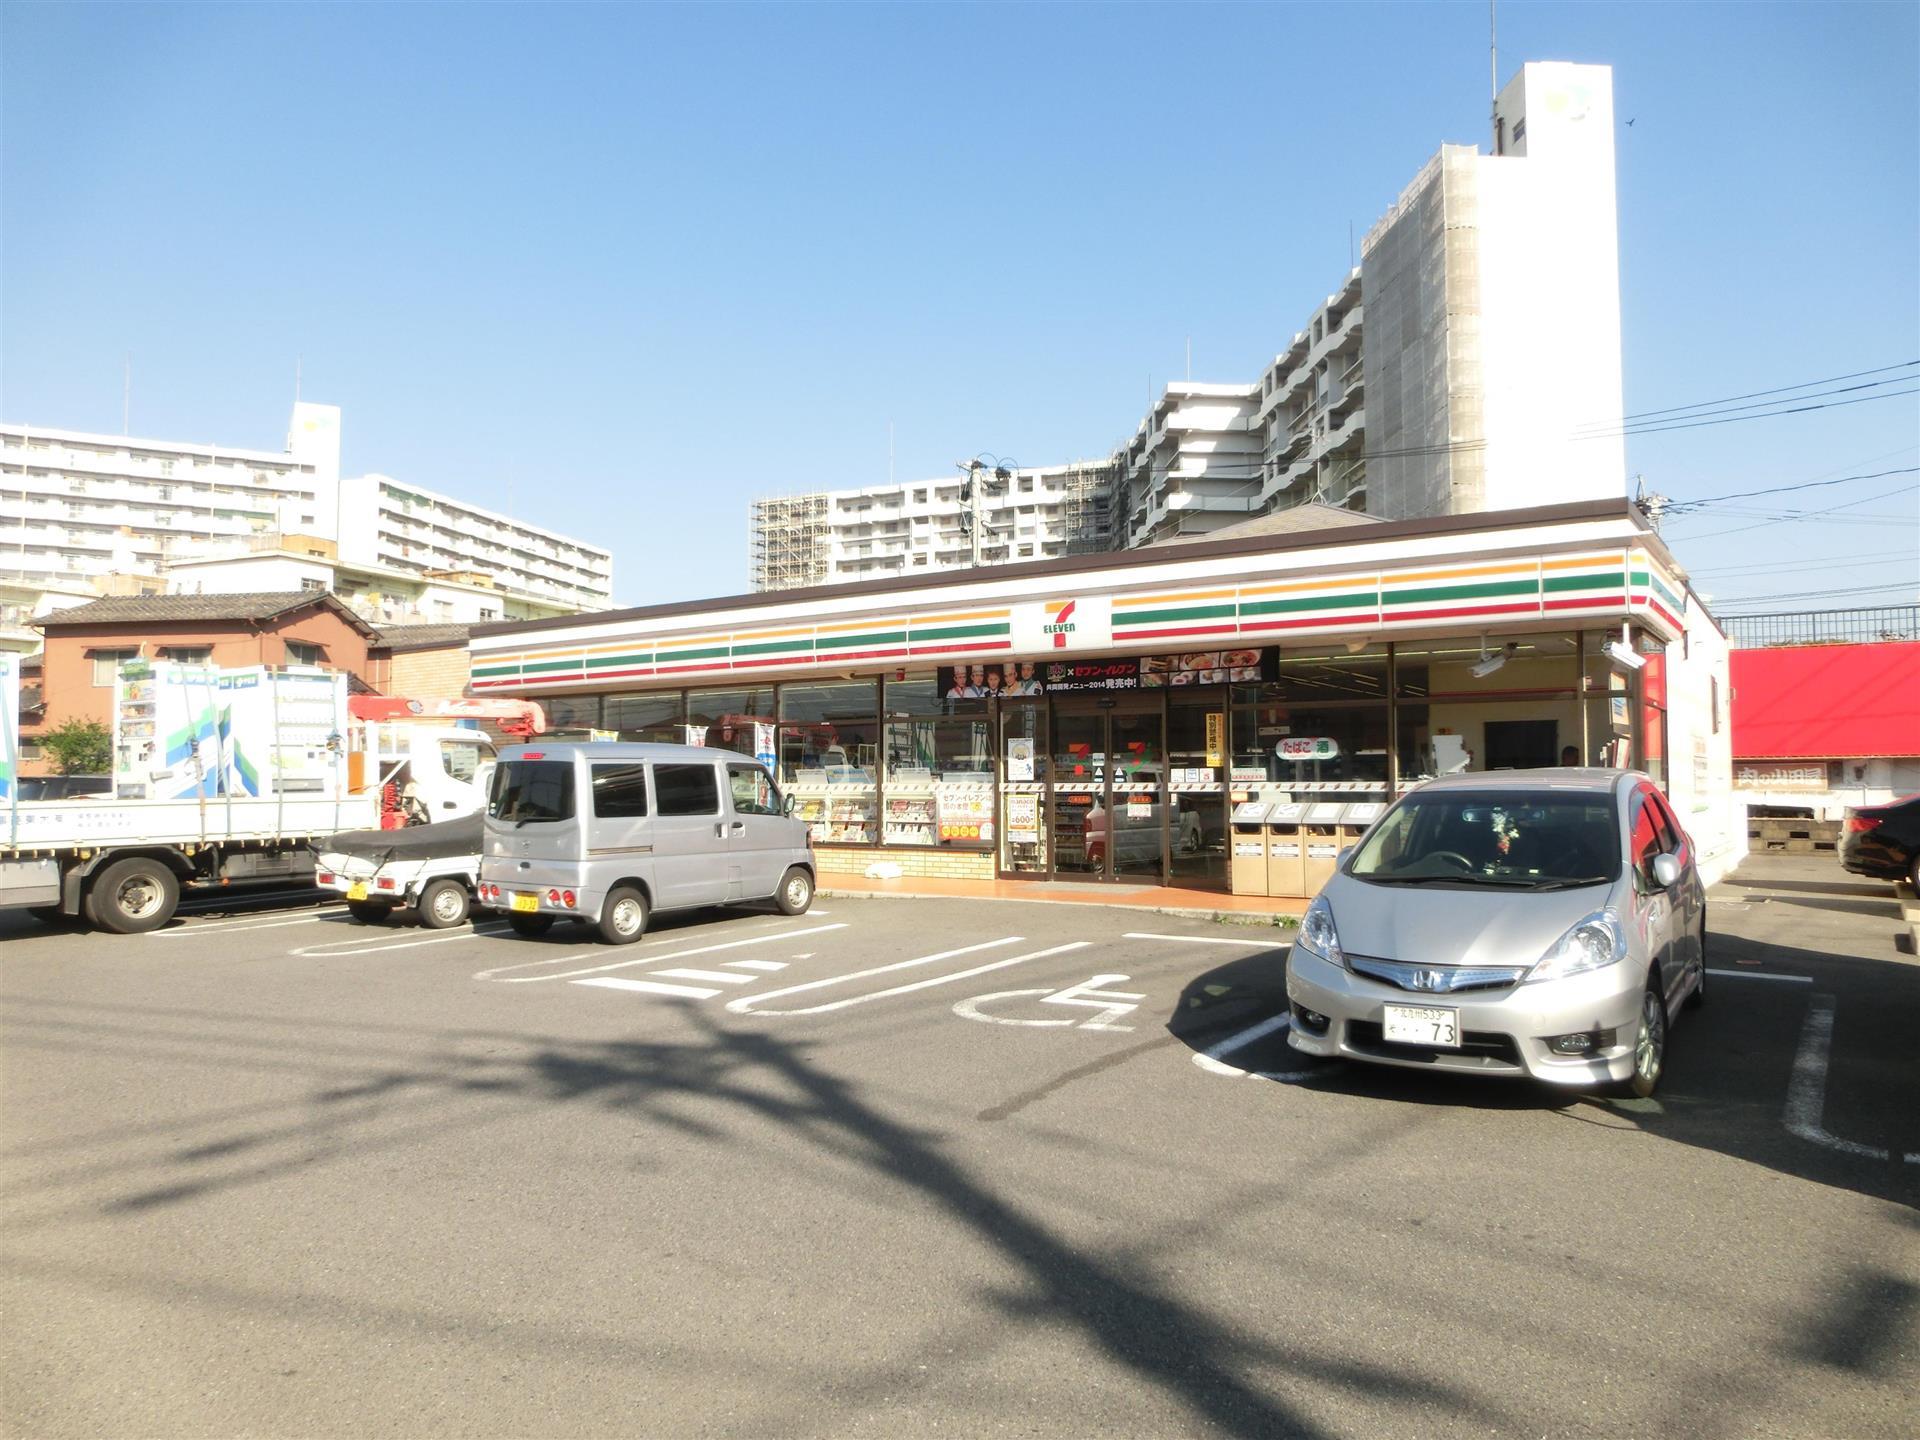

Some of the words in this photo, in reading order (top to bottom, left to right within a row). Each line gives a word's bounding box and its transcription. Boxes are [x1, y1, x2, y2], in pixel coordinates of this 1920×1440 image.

[1283, 741, 1311, 754] たばこ
[1316, 740, 1329, 754] 酒
[1738, 767, 1822, 786] 肉の山田屋
[1015, 815, 1031, 824] 600
